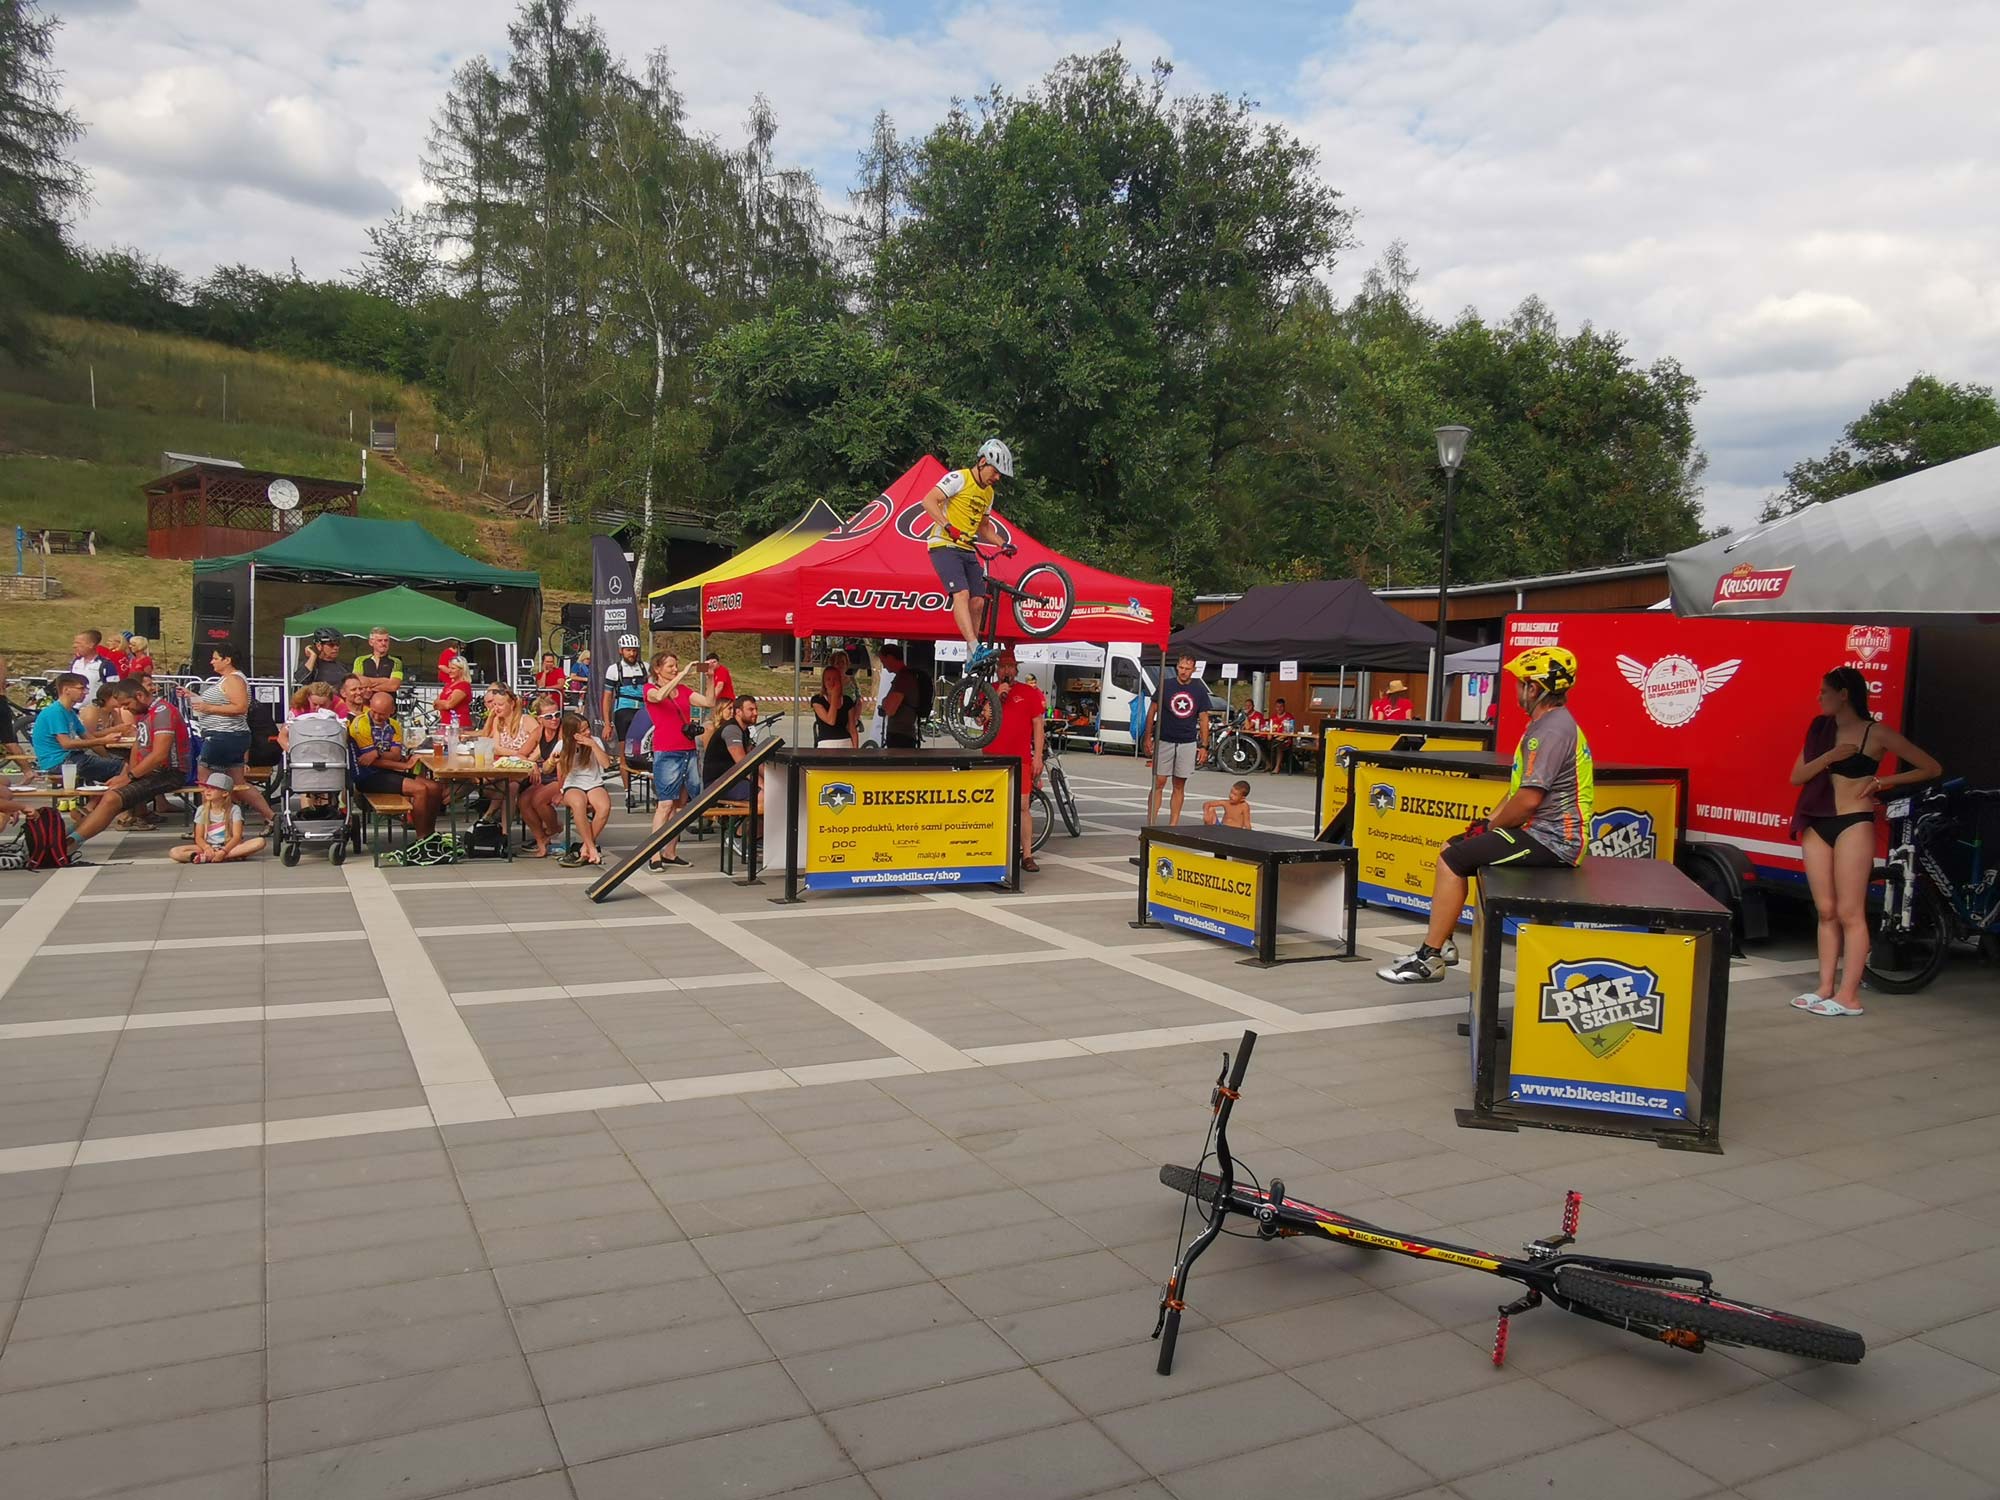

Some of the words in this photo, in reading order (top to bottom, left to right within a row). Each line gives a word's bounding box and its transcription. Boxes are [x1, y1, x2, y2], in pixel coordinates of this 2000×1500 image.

[1720, 577, 1783, 598] KRUŠOVICE
[706, 592, 743, 612] AUTHOR
[1647, 679, 1697, 693] TRIALSHOW
[862, 789, 995, 806] BIKESKILLS.CZ
[1400, 796, 1492, 822] BIKESKILLS
[1696, 804, 1709, 817] WE
[1710, 806, 1723, 819] DO
[1723, 807, 1732, 820] IT
[1733, 808, 1756, 823] WITH
[1757, 812, 1781, 827] LOVE
[819, 825, 850, 833] E-shop
[896, 822, 919, 832] které
[921, 823, 943, 831] sami
[1368, 828, 1389, 840] E-shop
[851, 870, 961, 884] www.bikeskills.cz/shop
[1177, 868, 1252, 897] BIKESKILLS.CZ
[1173, 914, 1226, 935] www.bikeskills.cz
[1551, 976, 1639, 1018] BIKE
[1580, 998, 1654, 1030] SKILLS
[1520, 1083, 1668, 1109] www.bikeskills.cz
[1355, 1232, 1369, 1242] BIG
[1370, 1236, 1398, 1247] SHOCK!
